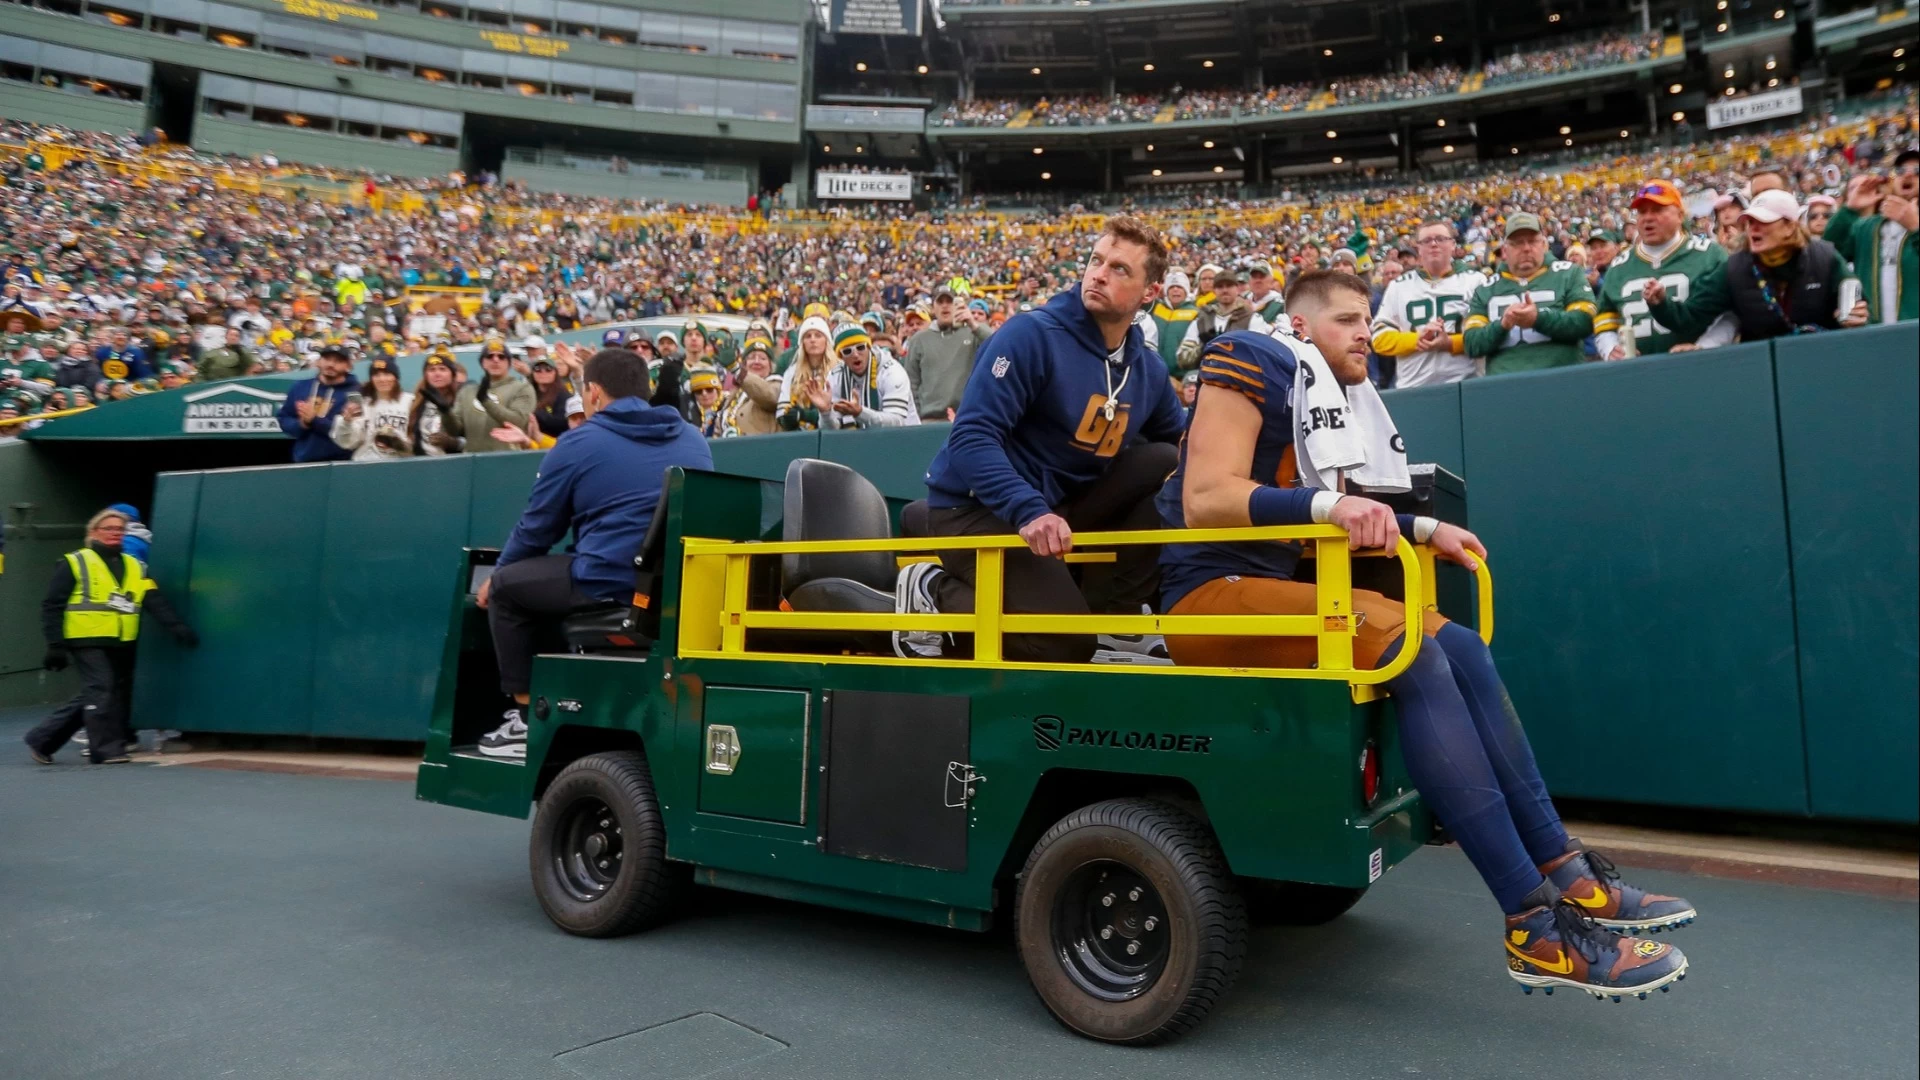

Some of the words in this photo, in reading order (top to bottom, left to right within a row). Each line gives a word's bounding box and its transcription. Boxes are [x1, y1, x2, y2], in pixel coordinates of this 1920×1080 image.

[827, 177, 858, 194] Lite
[860, 182, 893, 192] DECK
[1406, 295, 1464, 336] 85
[188, 403, 273, 417] AMERICAN
[1067, 728, 1213, 754] PAYLOADER
